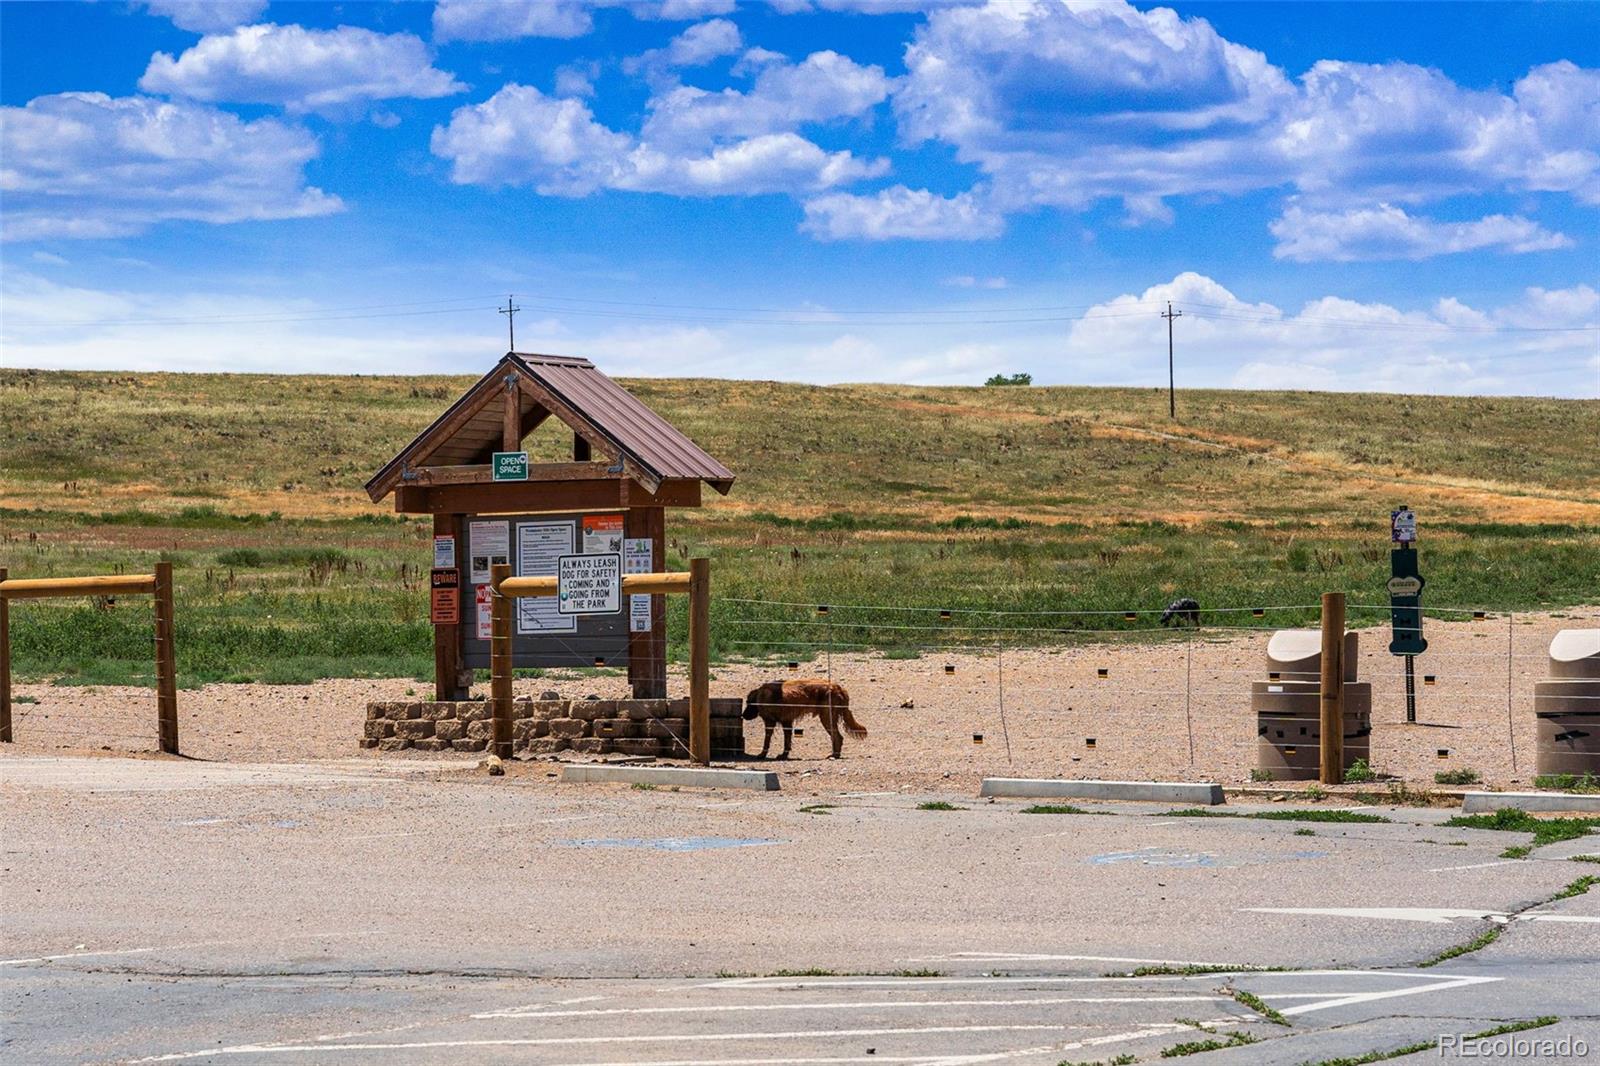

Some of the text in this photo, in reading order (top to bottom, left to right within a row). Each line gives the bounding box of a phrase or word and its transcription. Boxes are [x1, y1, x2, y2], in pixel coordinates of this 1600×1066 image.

[500, 457, 519, 465] OPEN
[499, 465, 522, 473] SPACE
[562, 559, 591, 569] ALWAYS
[593, 558, 617, 568] LEASH
[433, 573, 457, 584] BEWARE
[562, 568, 616, 579] DOG FOR SAFETY
[568, 579, 610, 589] COMING AND
[569, 589, 610, 599] GOING FROM
[572, 599, 606, 609] THE PARK
